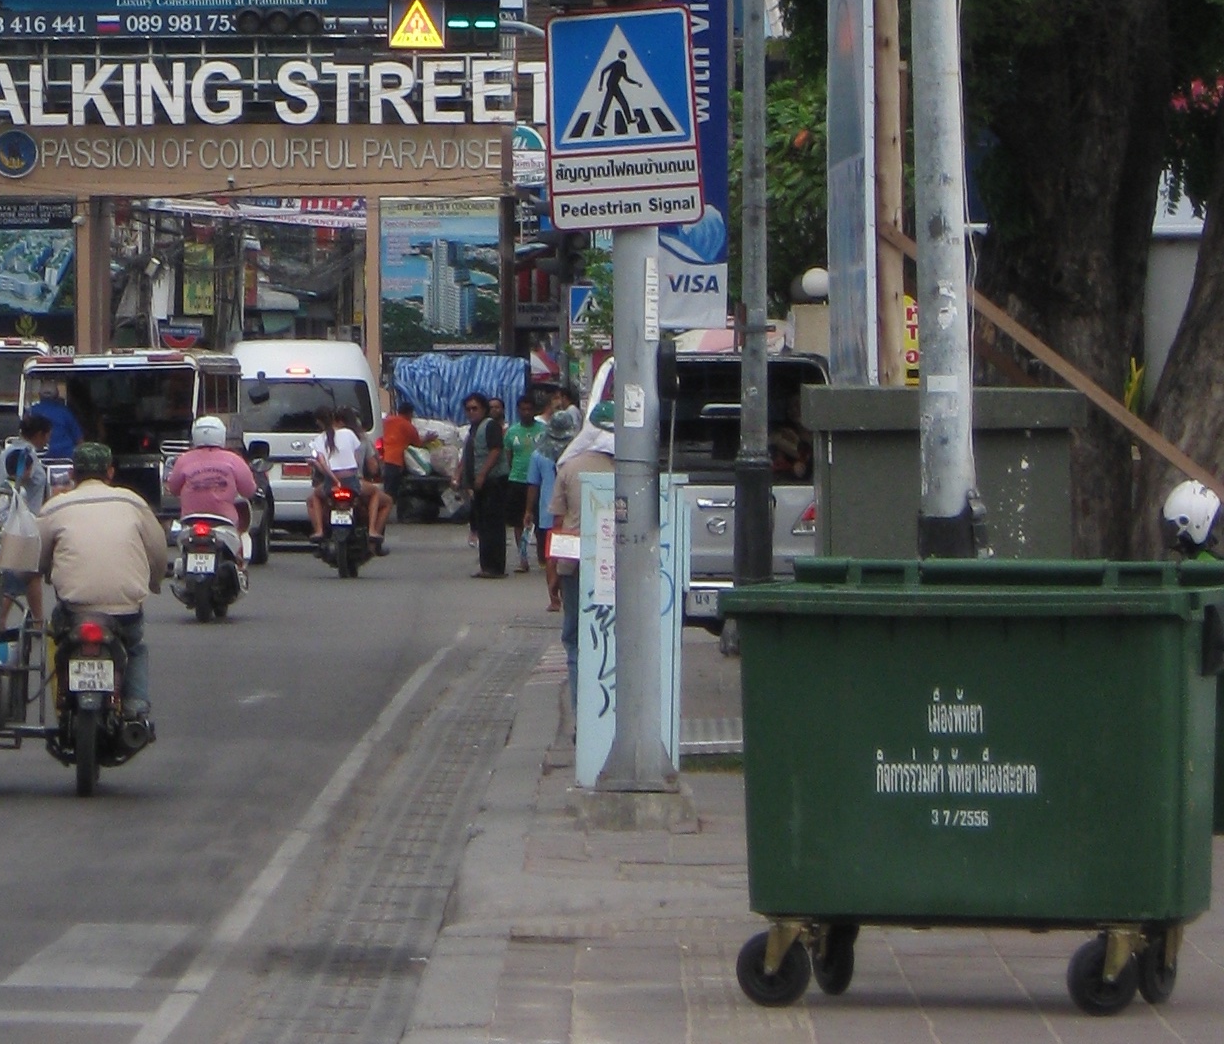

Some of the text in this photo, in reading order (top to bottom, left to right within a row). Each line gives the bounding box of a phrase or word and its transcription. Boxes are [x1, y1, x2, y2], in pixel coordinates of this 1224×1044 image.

[10, 16, 47, 34] 416
[51, 15, 86, 34] 441
[126, 14, 163, 32] 089
[168, 14, 202, 32] 981
[274, 59, 547, 126] STREET
[40, 137, 156, 169] PASSION
[161, 137, 194, 169] OF
[199, 137, 357, 170] COLOURFUL
[362, 137, 503, 170] PARADISE
[555, 158, 695, 183] สัญญาณไฟคนข้ามถนน
[561, 195, 695, 217] Pedestrian Signal
[666, 274, 720, 294] VISA
[927, 687, 984, 734] เมืองพัทยา
